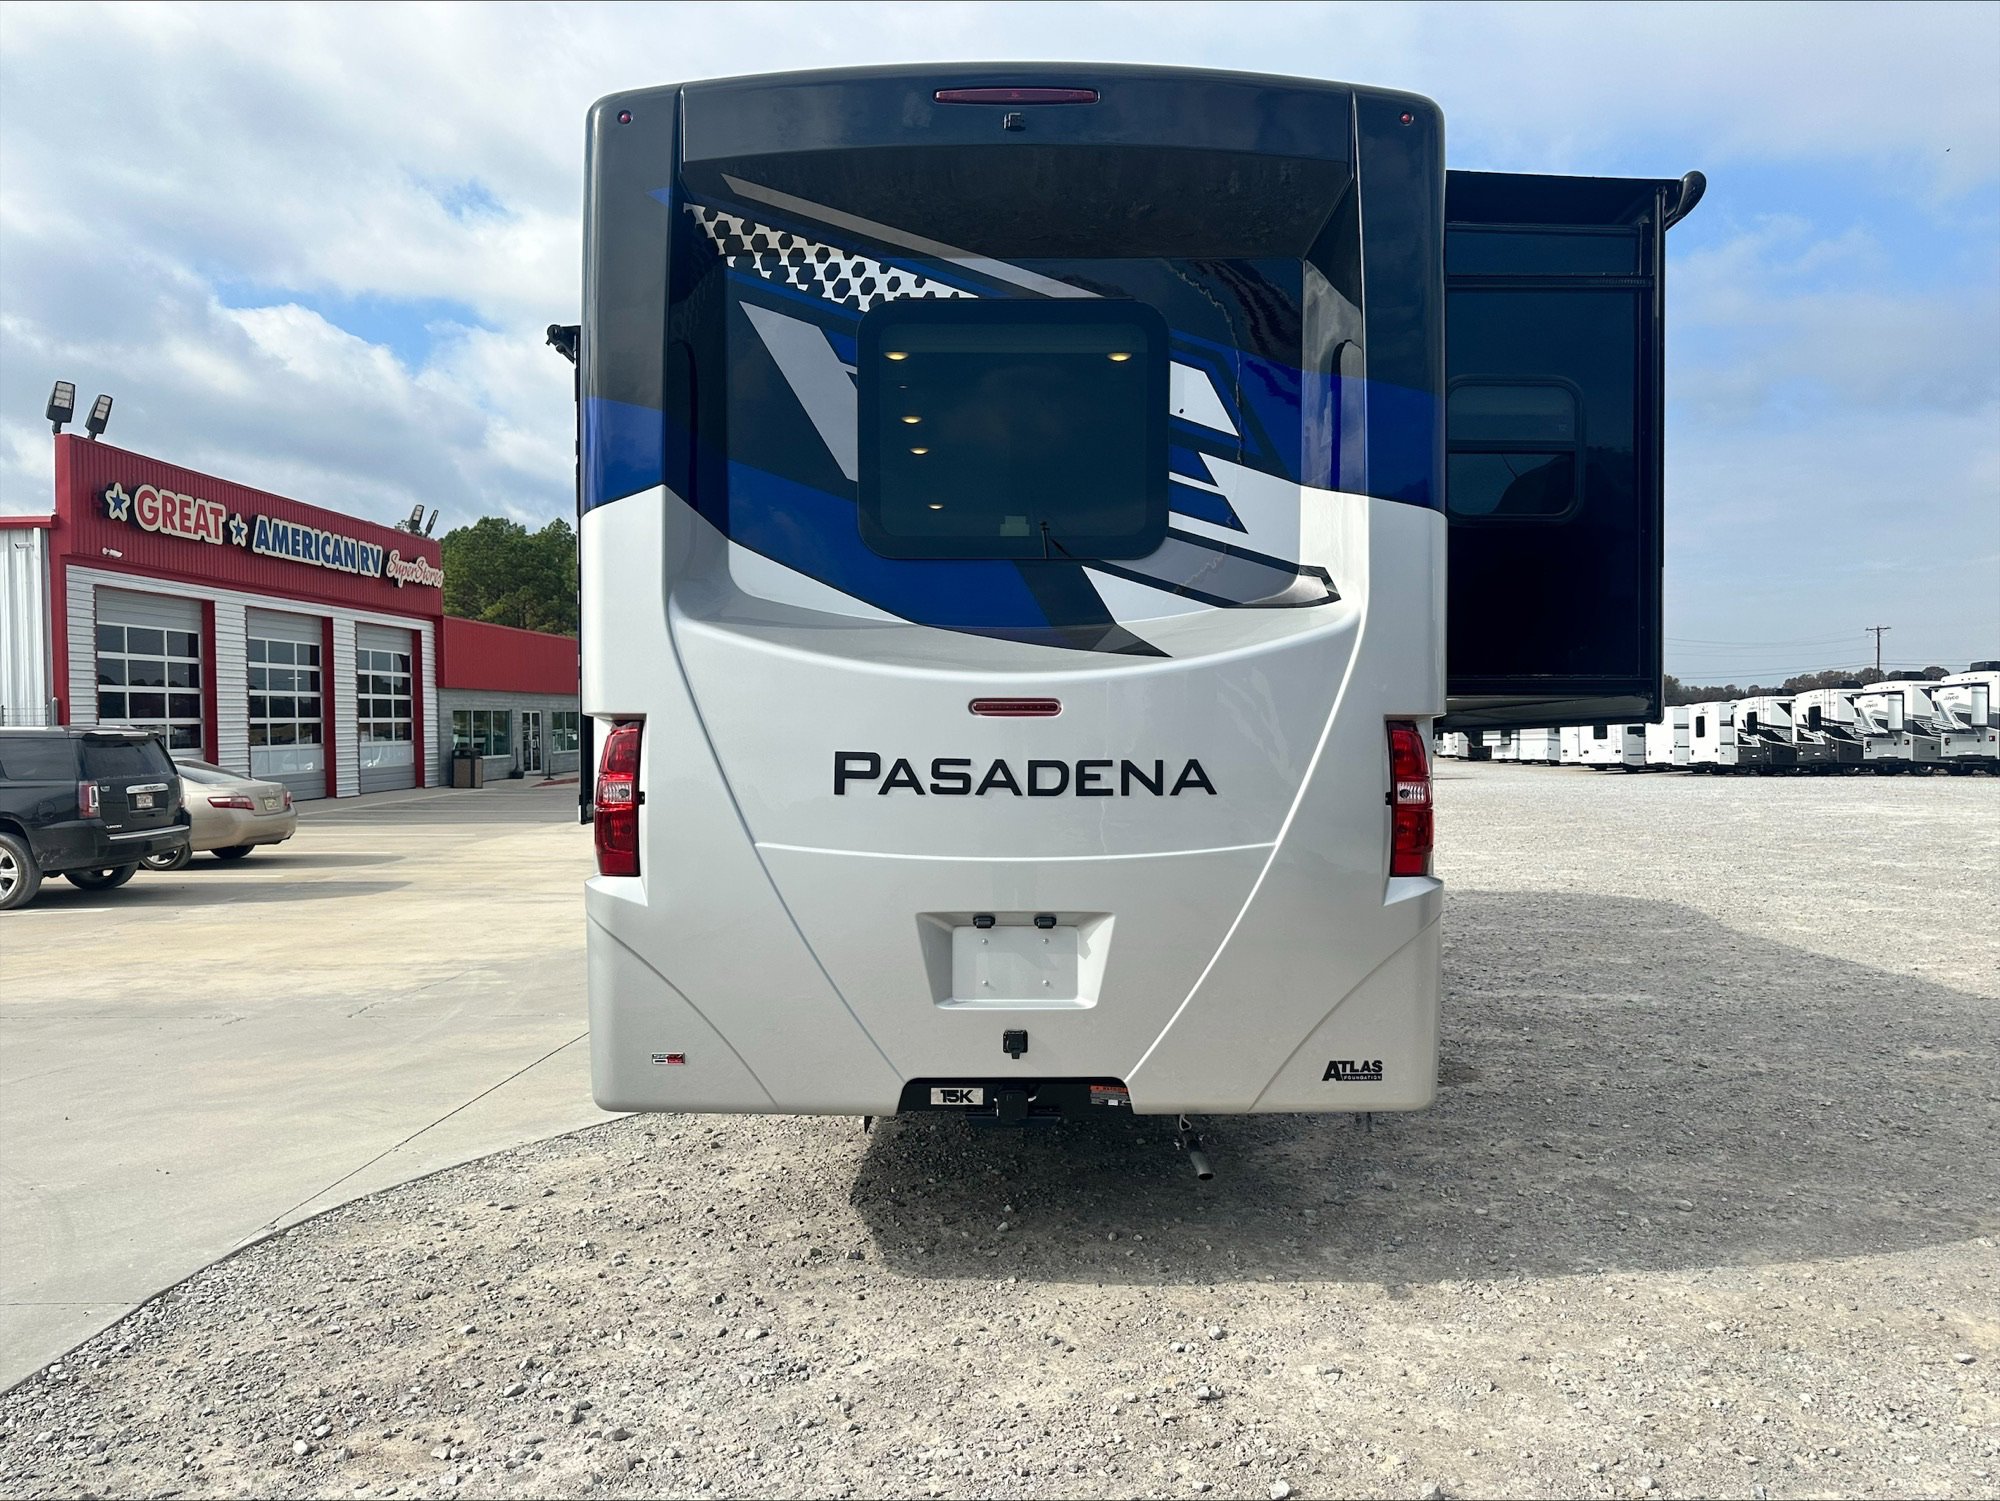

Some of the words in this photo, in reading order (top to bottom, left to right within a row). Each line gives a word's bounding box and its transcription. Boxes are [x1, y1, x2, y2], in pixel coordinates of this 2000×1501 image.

[135, 485, 225, 544] GREAT
[254, 515, 357, 573] AMERICAN
[358, 543, 382, 577] RV
[833, 751, 1218, 797] PASADENA
[1321, 1060, 1383, 1081] ATLAS
[940, 1089, 974, 1103] 15K
